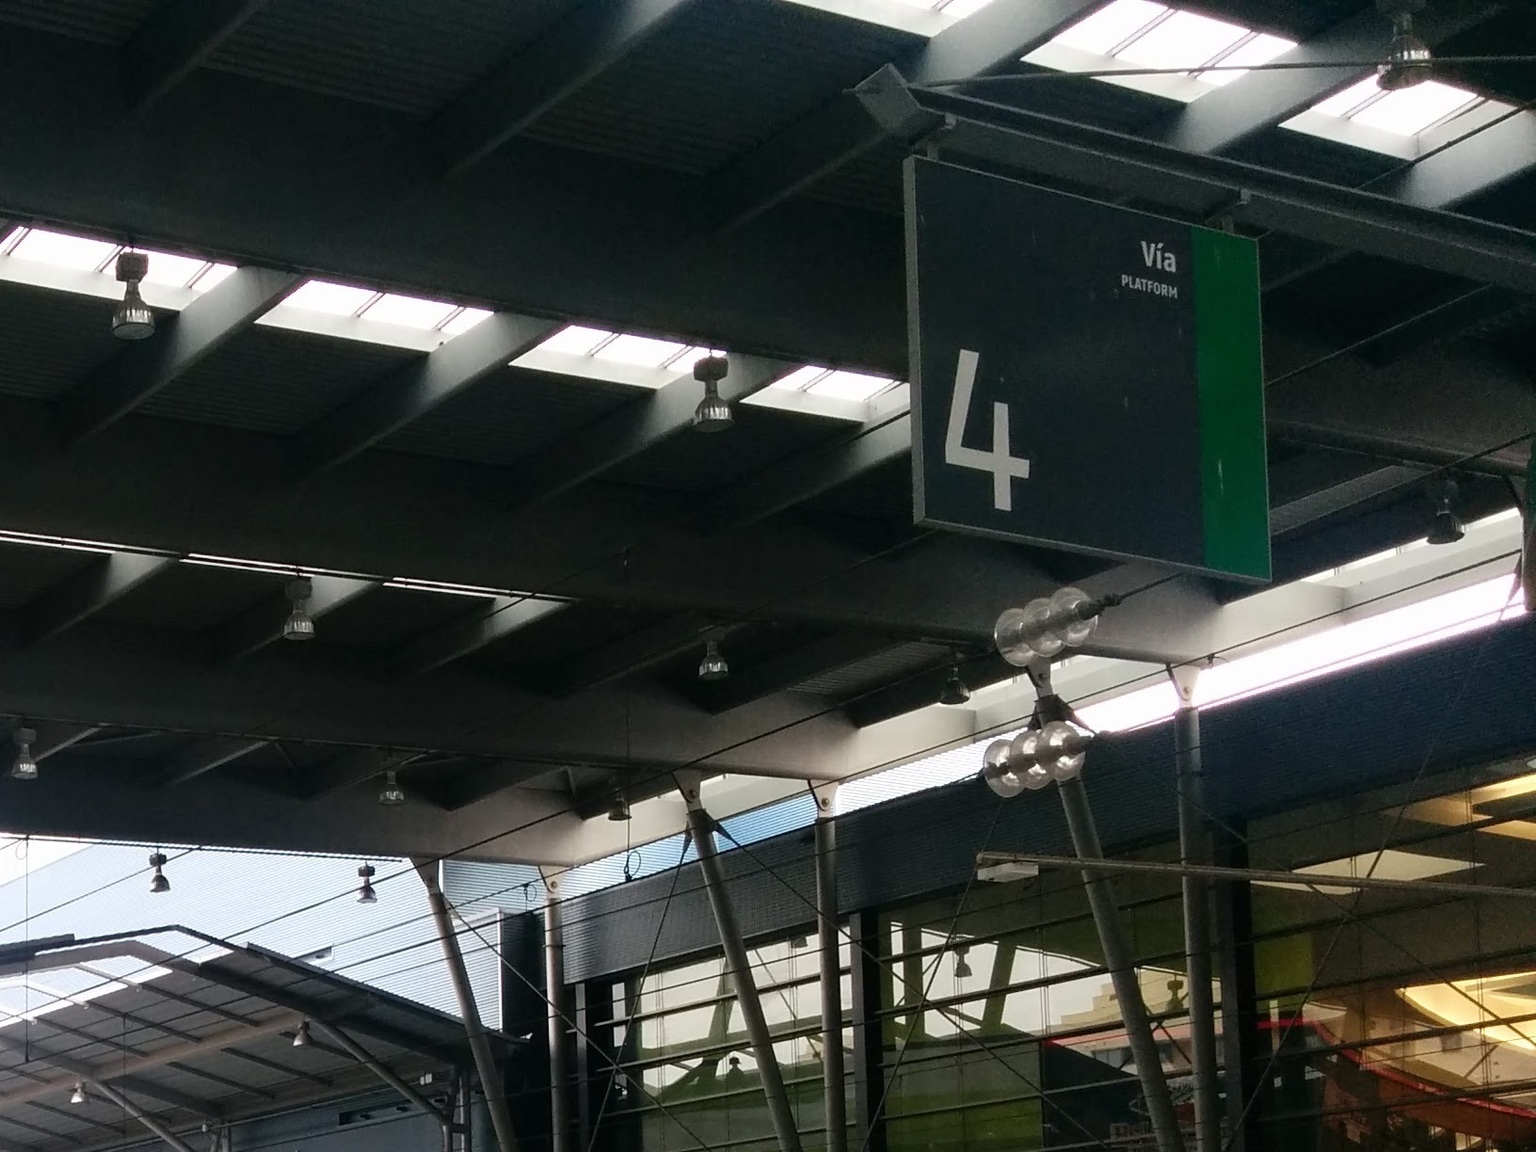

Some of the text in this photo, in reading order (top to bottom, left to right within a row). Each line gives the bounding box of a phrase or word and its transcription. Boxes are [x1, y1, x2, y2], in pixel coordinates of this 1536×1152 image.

[1141, 241, 1176, 273] Vía
[1121, 274, 1178, 299] PLATFORM
[945, 349, 1030, 511] 4
